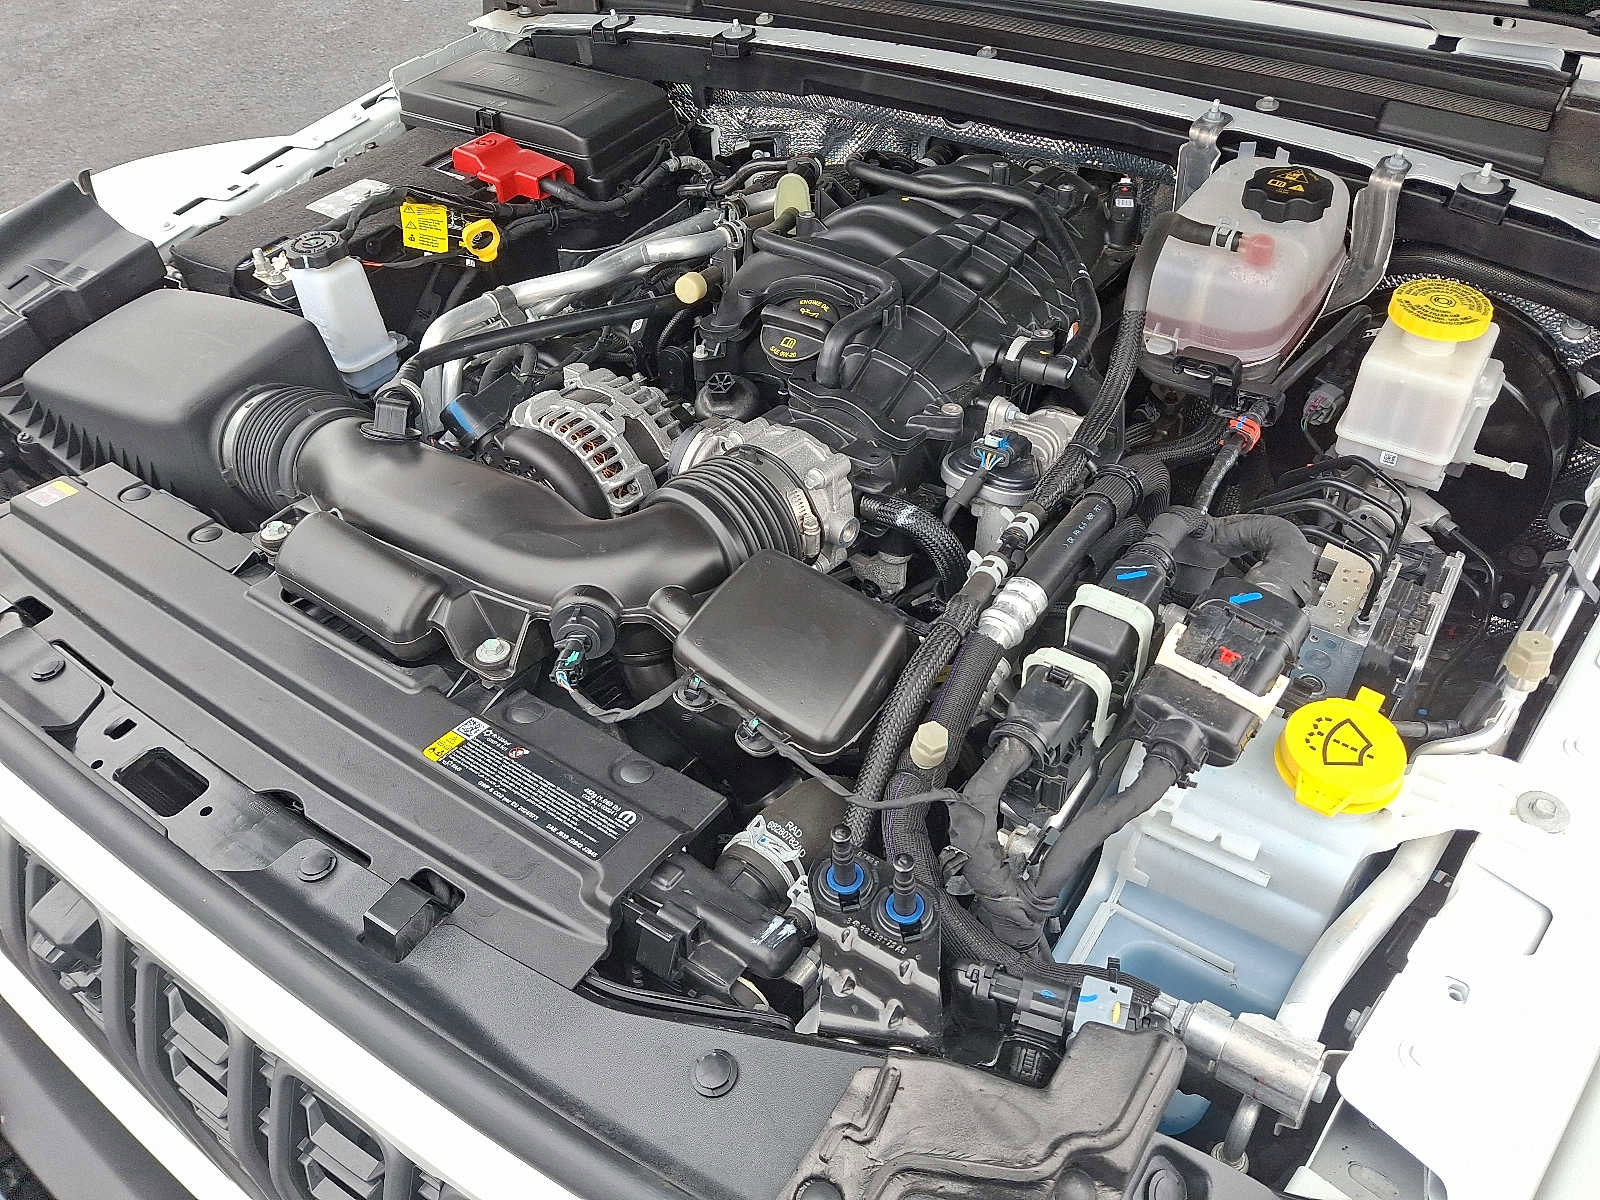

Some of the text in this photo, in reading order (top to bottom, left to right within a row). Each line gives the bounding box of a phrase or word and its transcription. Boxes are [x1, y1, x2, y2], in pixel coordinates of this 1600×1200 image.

[770, 345, 780, 356] SAE
[546, 824, 558, 833] SAE
[785, 820, 802, 838] RAD
